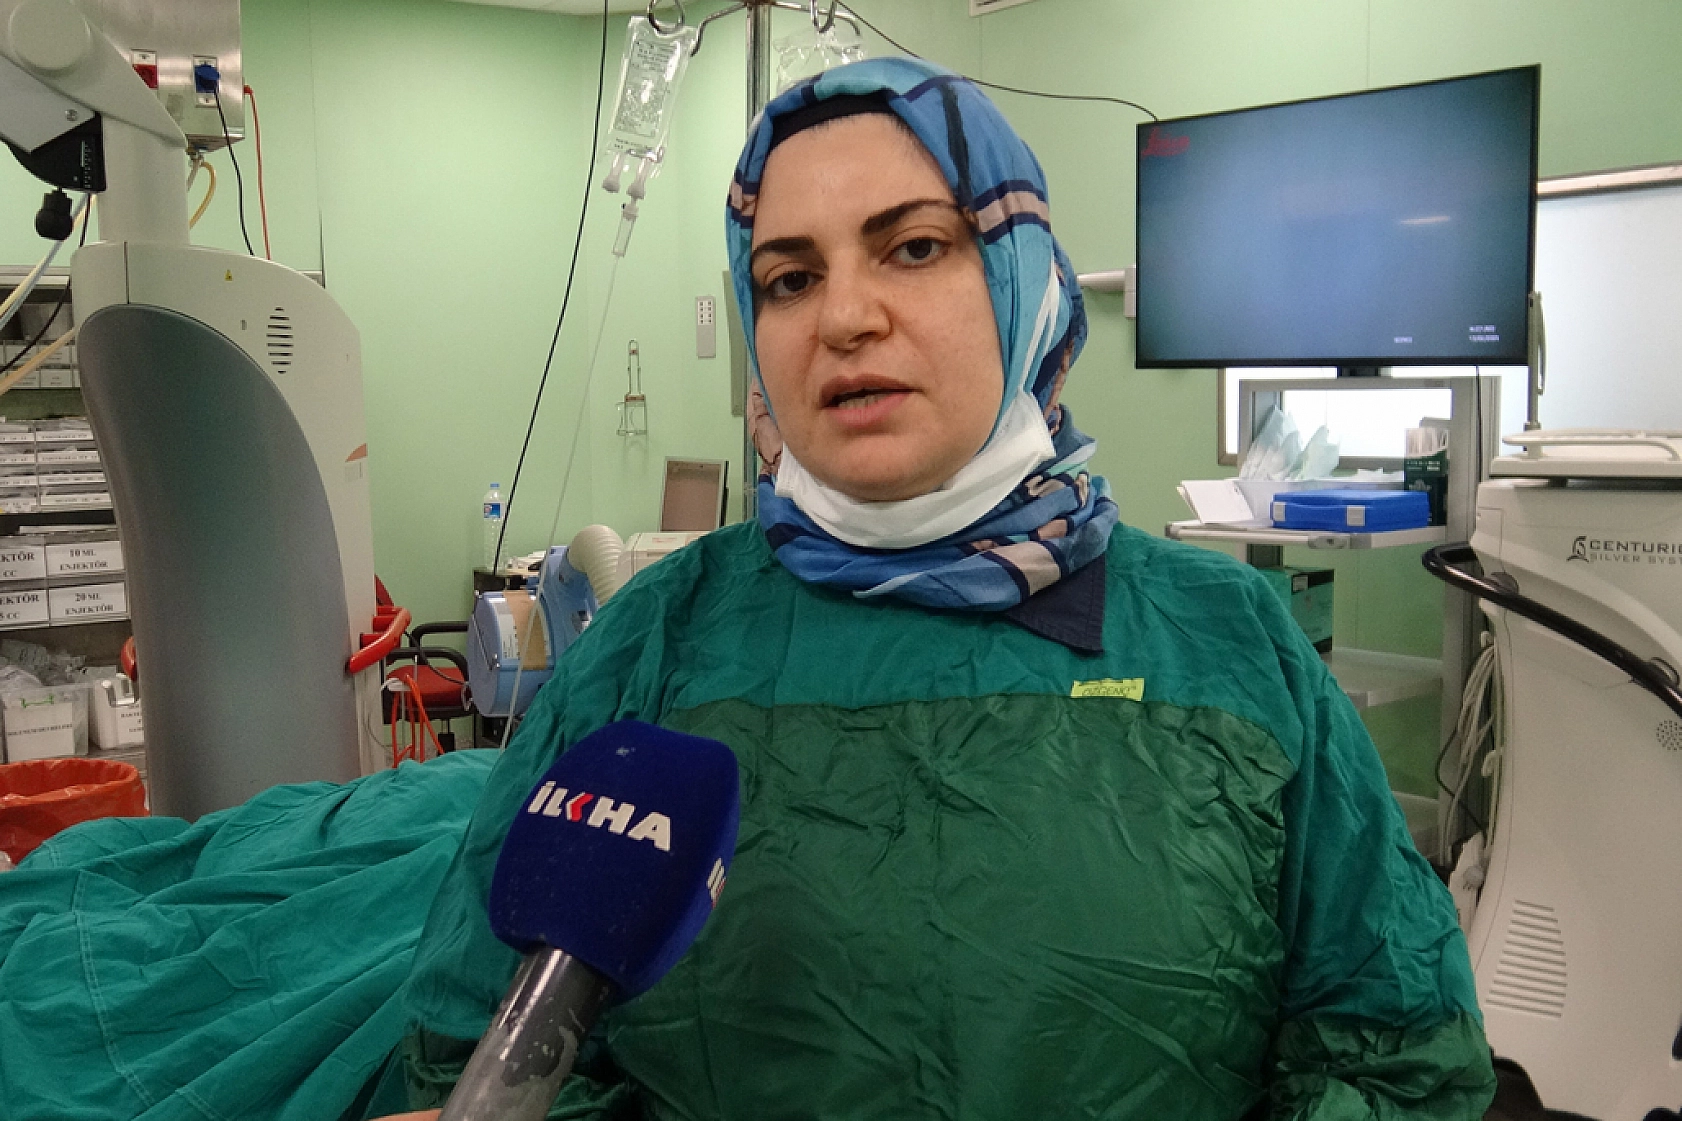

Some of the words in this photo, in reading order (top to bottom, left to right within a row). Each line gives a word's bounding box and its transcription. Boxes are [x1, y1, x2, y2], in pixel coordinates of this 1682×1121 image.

[1590, 553, 1640, 562] SILVER
[60, 561, 108, 571] ENJEKTÖR
[65, 604, 113, 615] ENJEKTÖR
